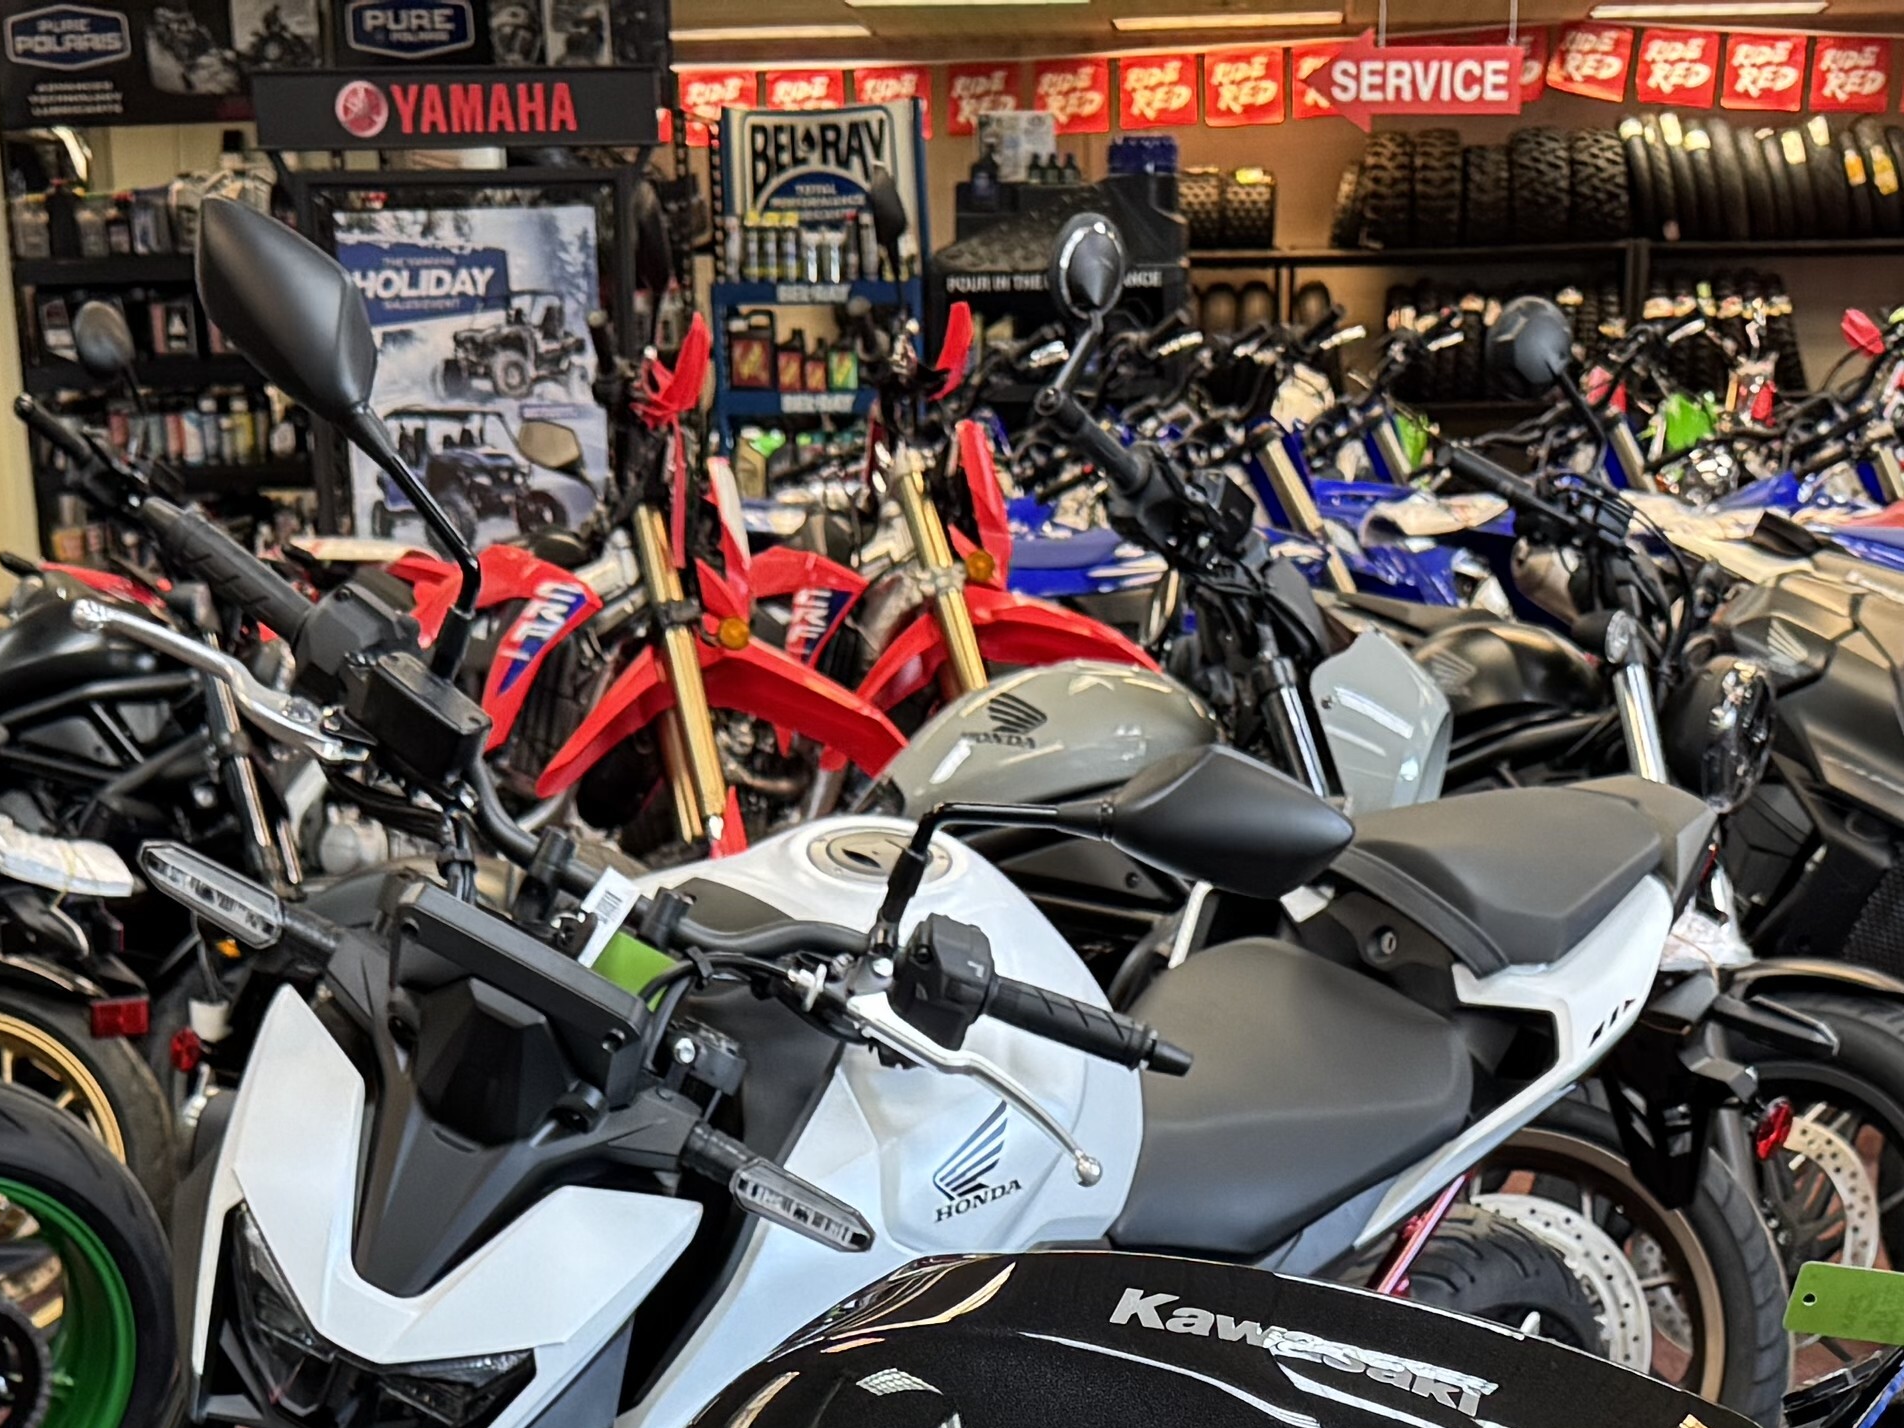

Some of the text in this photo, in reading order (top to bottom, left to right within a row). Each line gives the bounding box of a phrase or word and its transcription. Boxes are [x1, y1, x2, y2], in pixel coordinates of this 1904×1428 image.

[364, 9, 455, 32] PURE
[14, 33, 122, 54] POLARIS
[1645, 38, 1706, 62] RIDE
[1732, 41, 1794, 67] RIDE
[1820, 46, 1881, 71] RIDE
[1124, 60, 1183, 88] RIDE
[1211, 56, 1269, 85] RIDE
[1330, 60, 1509, 102] SERVICE
[1564, 52, 1624, 82] RED
[1647, 62, 1711, 94] RED
[1735, 65, 1797, 98] RED
[1217, 81, 1278, 114] RED
[1821, 69, 1886, 102] RED
[390, 82, 577, 134] YAMAHA
[1047, 92, 1106, 124] RED
[1131, 85, 1192, 120] RED
[352, 267, 494, 299] HOLIDAY
[934, 1174, 1022, 1222] HONDA
[1108, 1287, 1498, 1417] Kawasaki
